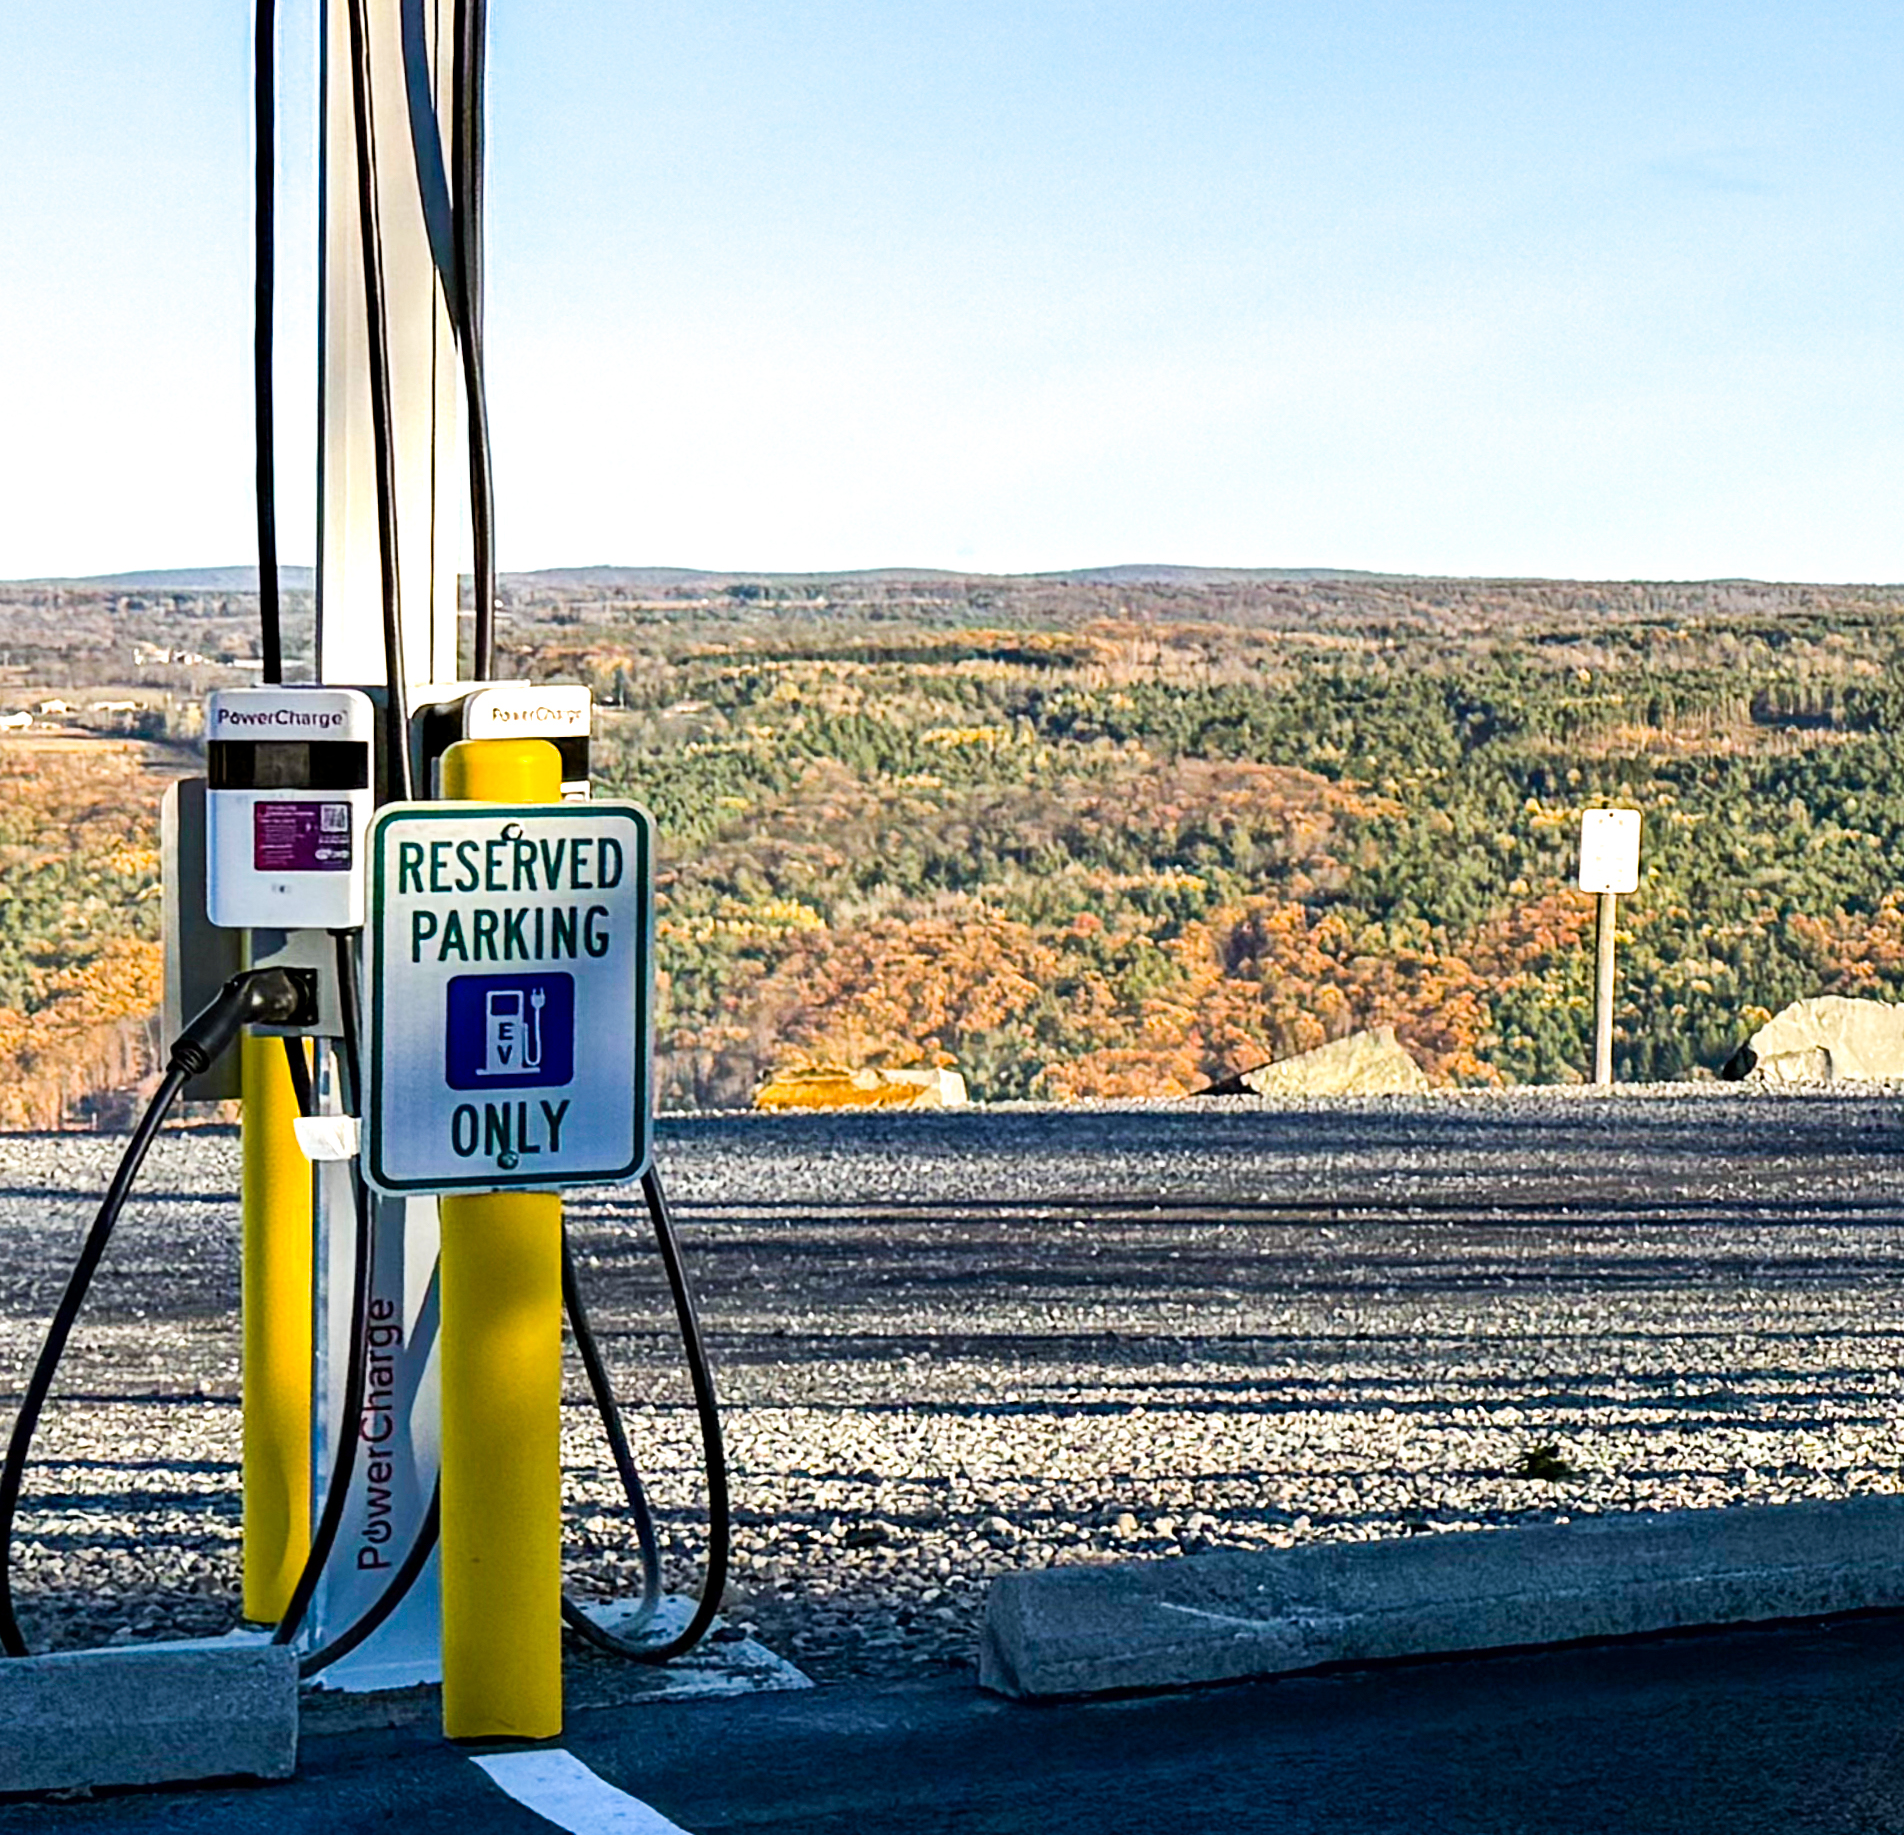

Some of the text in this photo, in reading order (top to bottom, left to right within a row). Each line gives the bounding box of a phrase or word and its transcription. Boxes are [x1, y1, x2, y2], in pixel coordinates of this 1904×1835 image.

[218, 708, 343, 729] PowerCharge
[398, 838, 624, 894] RESERVED
[411, 905, 610, 964] PARKING
[451, 1100, 571, 1157] ONLY
[358, 1297, 402, 1571] PowerCharge
